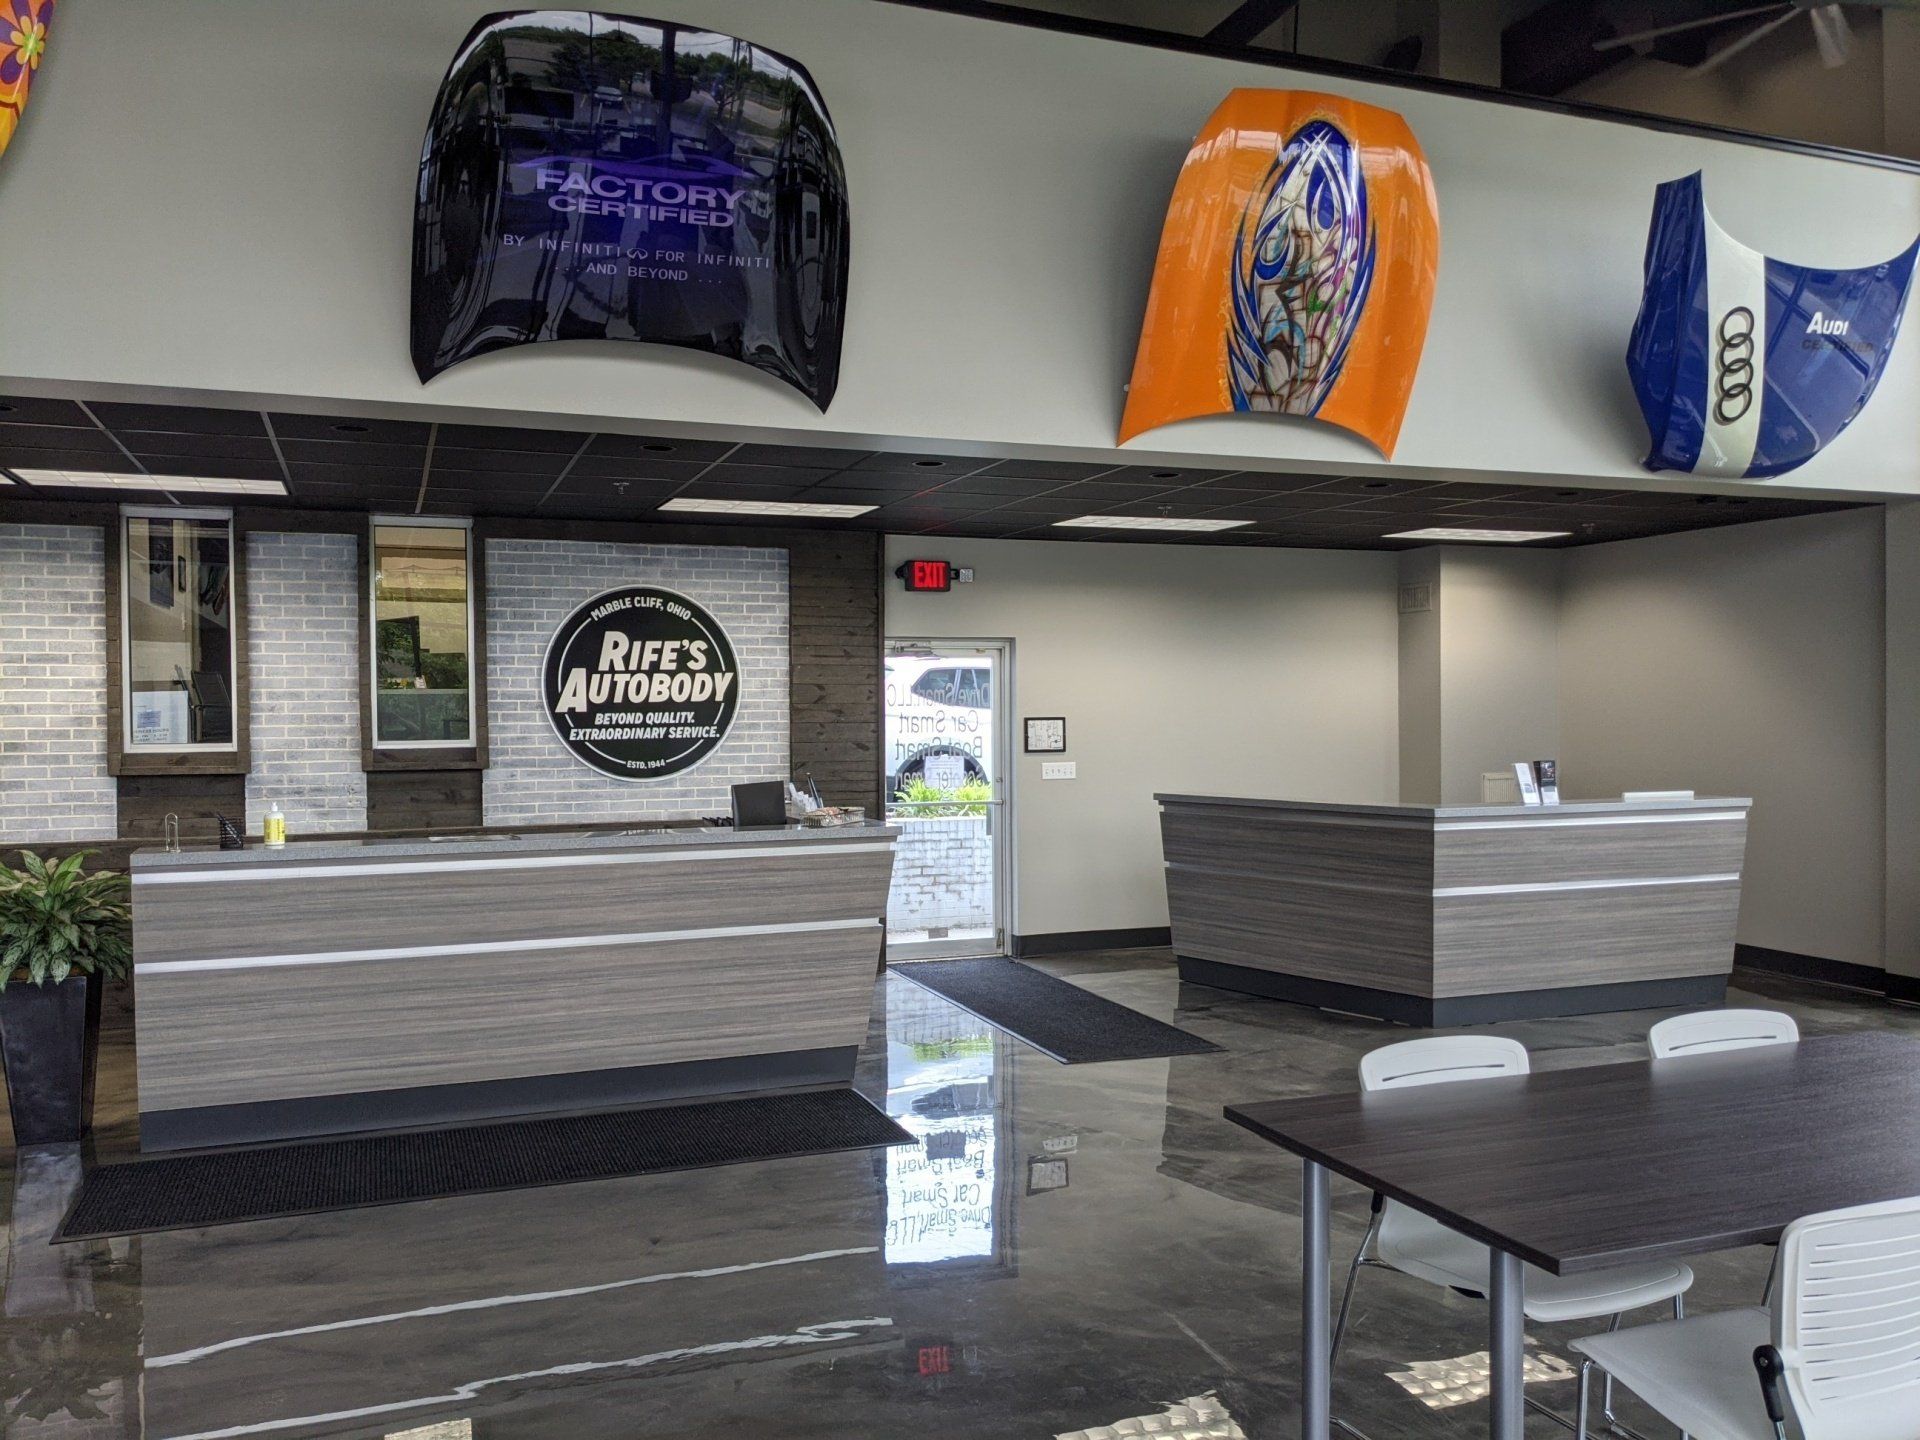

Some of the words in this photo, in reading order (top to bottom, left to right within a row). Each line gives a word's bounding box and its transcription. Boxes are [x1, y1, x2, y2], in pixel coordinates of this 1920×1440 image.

[536, 169, 746, 209] FACTORY
[548, 195, 734, 227] CERTIFIED
[503, 234, 525, 247] BY
[539, 238, 620, 257] INFINITI
[655, 250, 685, 262] FOR
[698, 253, 770, 268] INFINITI
[628, 266, 688, 281] BEYOND
[914, 561, 946, 588] EXIT
[590, 597, 632, 621] MARBLE
[634, 596, 664, 611] CLIFF,
[666, 602, 692, 620] OHIO
[598, 630, 709, 671] RIFE'S
[554, 667, 734, 713] AUTOBODY
[594, 712, 644, 725] BEYOND
[645, 711, 695, 725] QUALITY.
[569, 727, 666, 741] EXTRAORDINARY
[668, 725, 720, 739] SERVICE.
[648, 758, 666, 768] 1944
